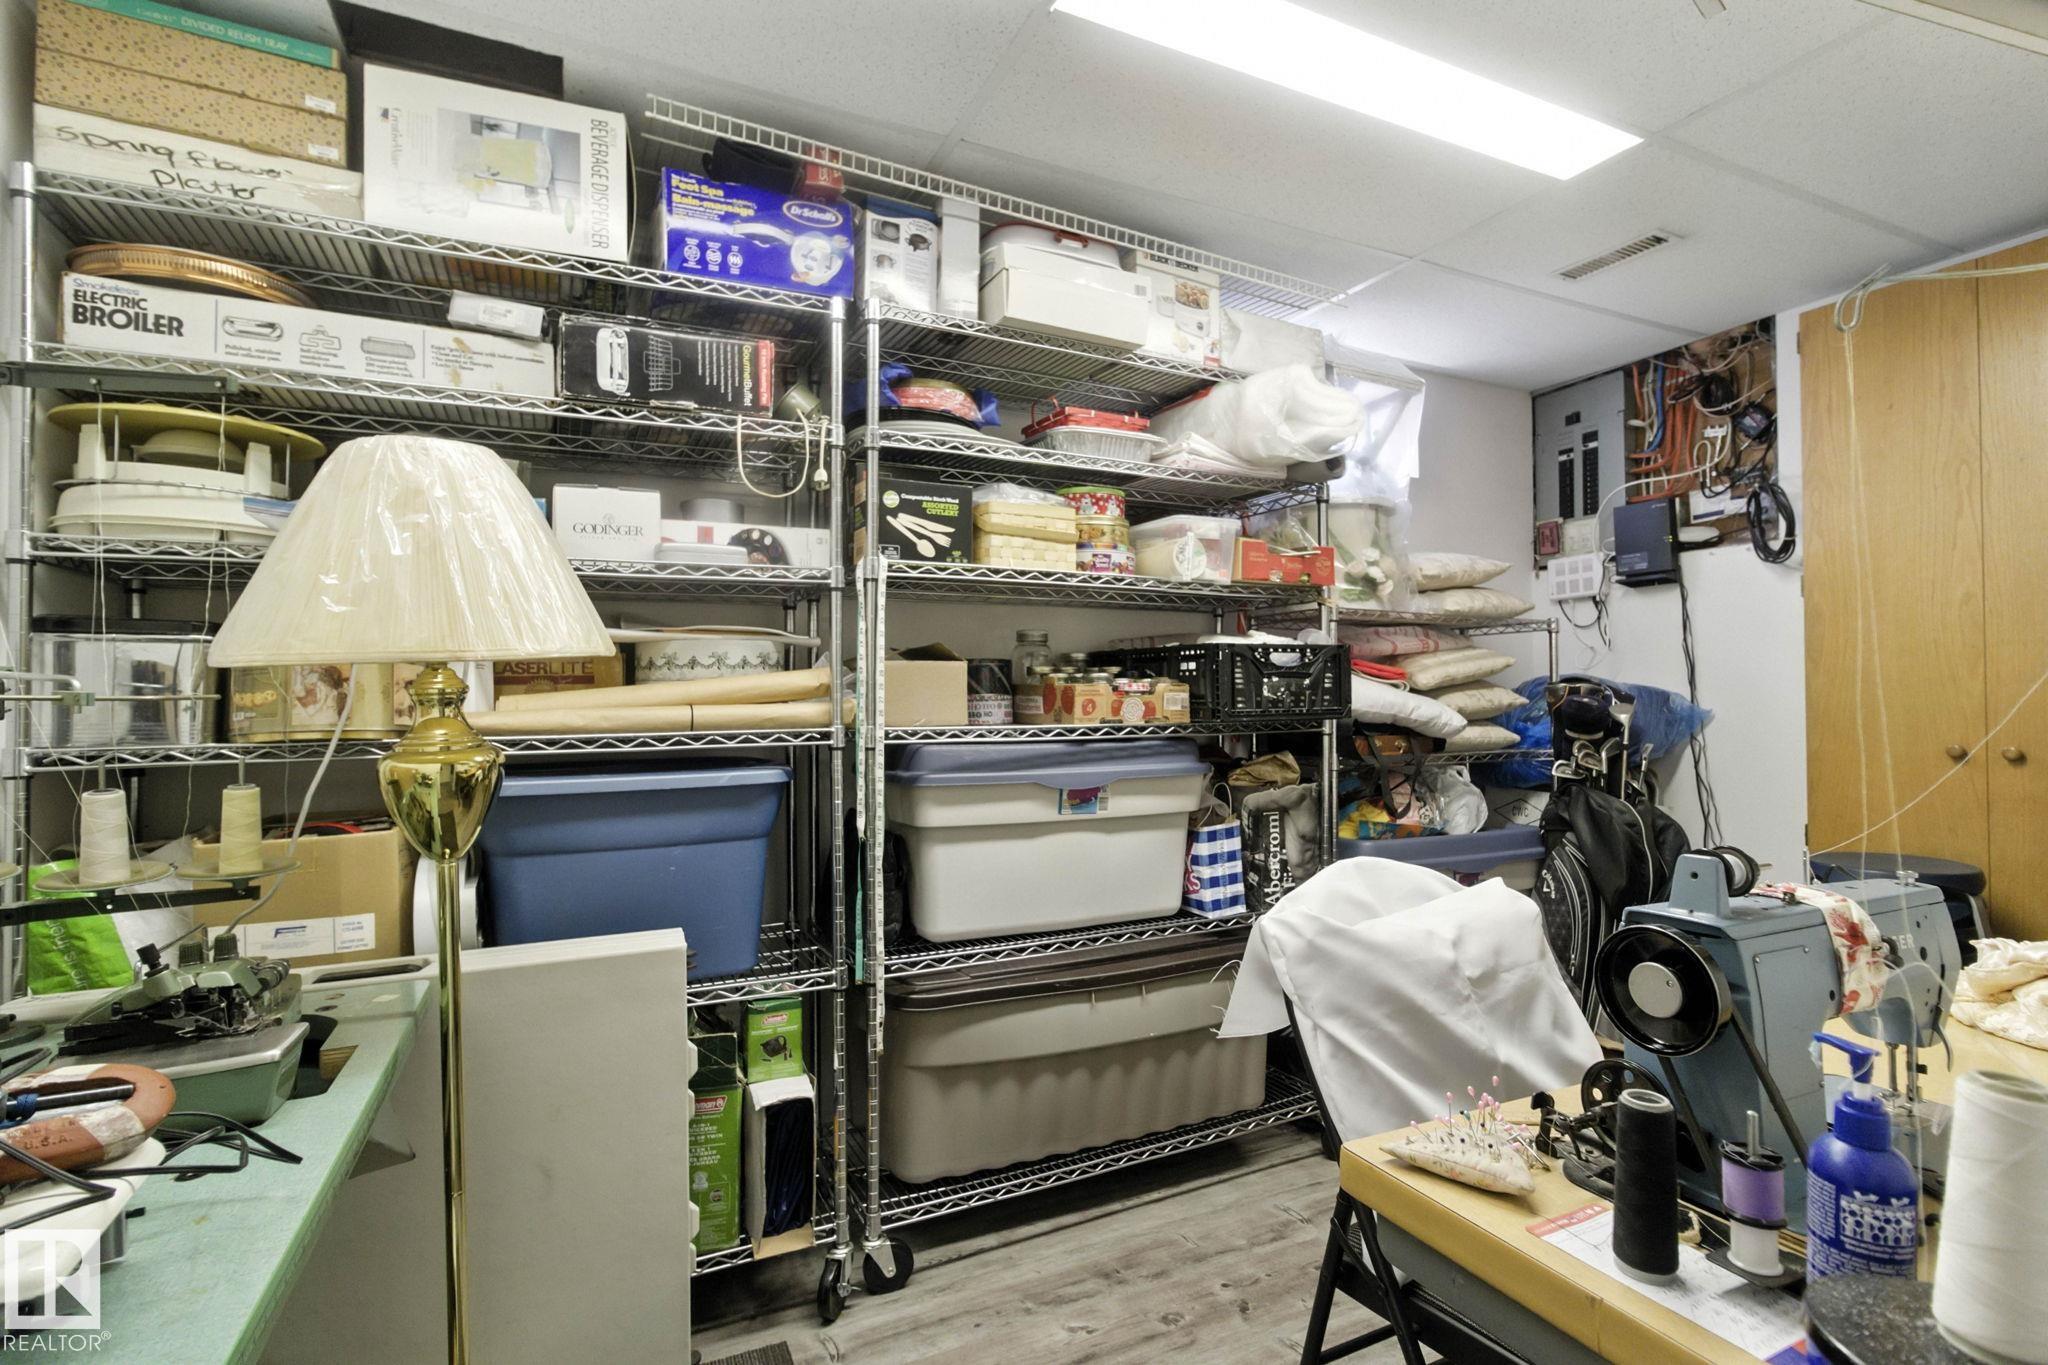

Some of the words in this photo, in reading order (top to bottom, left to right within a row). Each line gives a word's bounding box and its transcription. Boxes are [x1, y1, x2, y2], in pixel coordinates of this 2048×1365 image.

[180, 15, 225, 35] DIVIDED
[226, 28, 262, 45] RELISH
[263, 37, 289, 51] TRAY
[590, 118, 609, 182] BEVERAGE
[671, 177, 700, 193] Foot
[700, 184, 724, 199] Spa
[590, 182, 610, 250] DISPENSER
[671, 193, 755, 217] Bain-massage
[72, 288, 148, 311] ELECTRIC
[71, 302, 185, 338] BROILER
[743, 344, 753, 407] GourmetBuffet
[921, 501, 960, 511] ASSORTED
[926, 508, 960, 517] CUTLERY
[572, 521, 643, 537] GODINGER
[494, 660, 594, 676] LASERLITE
